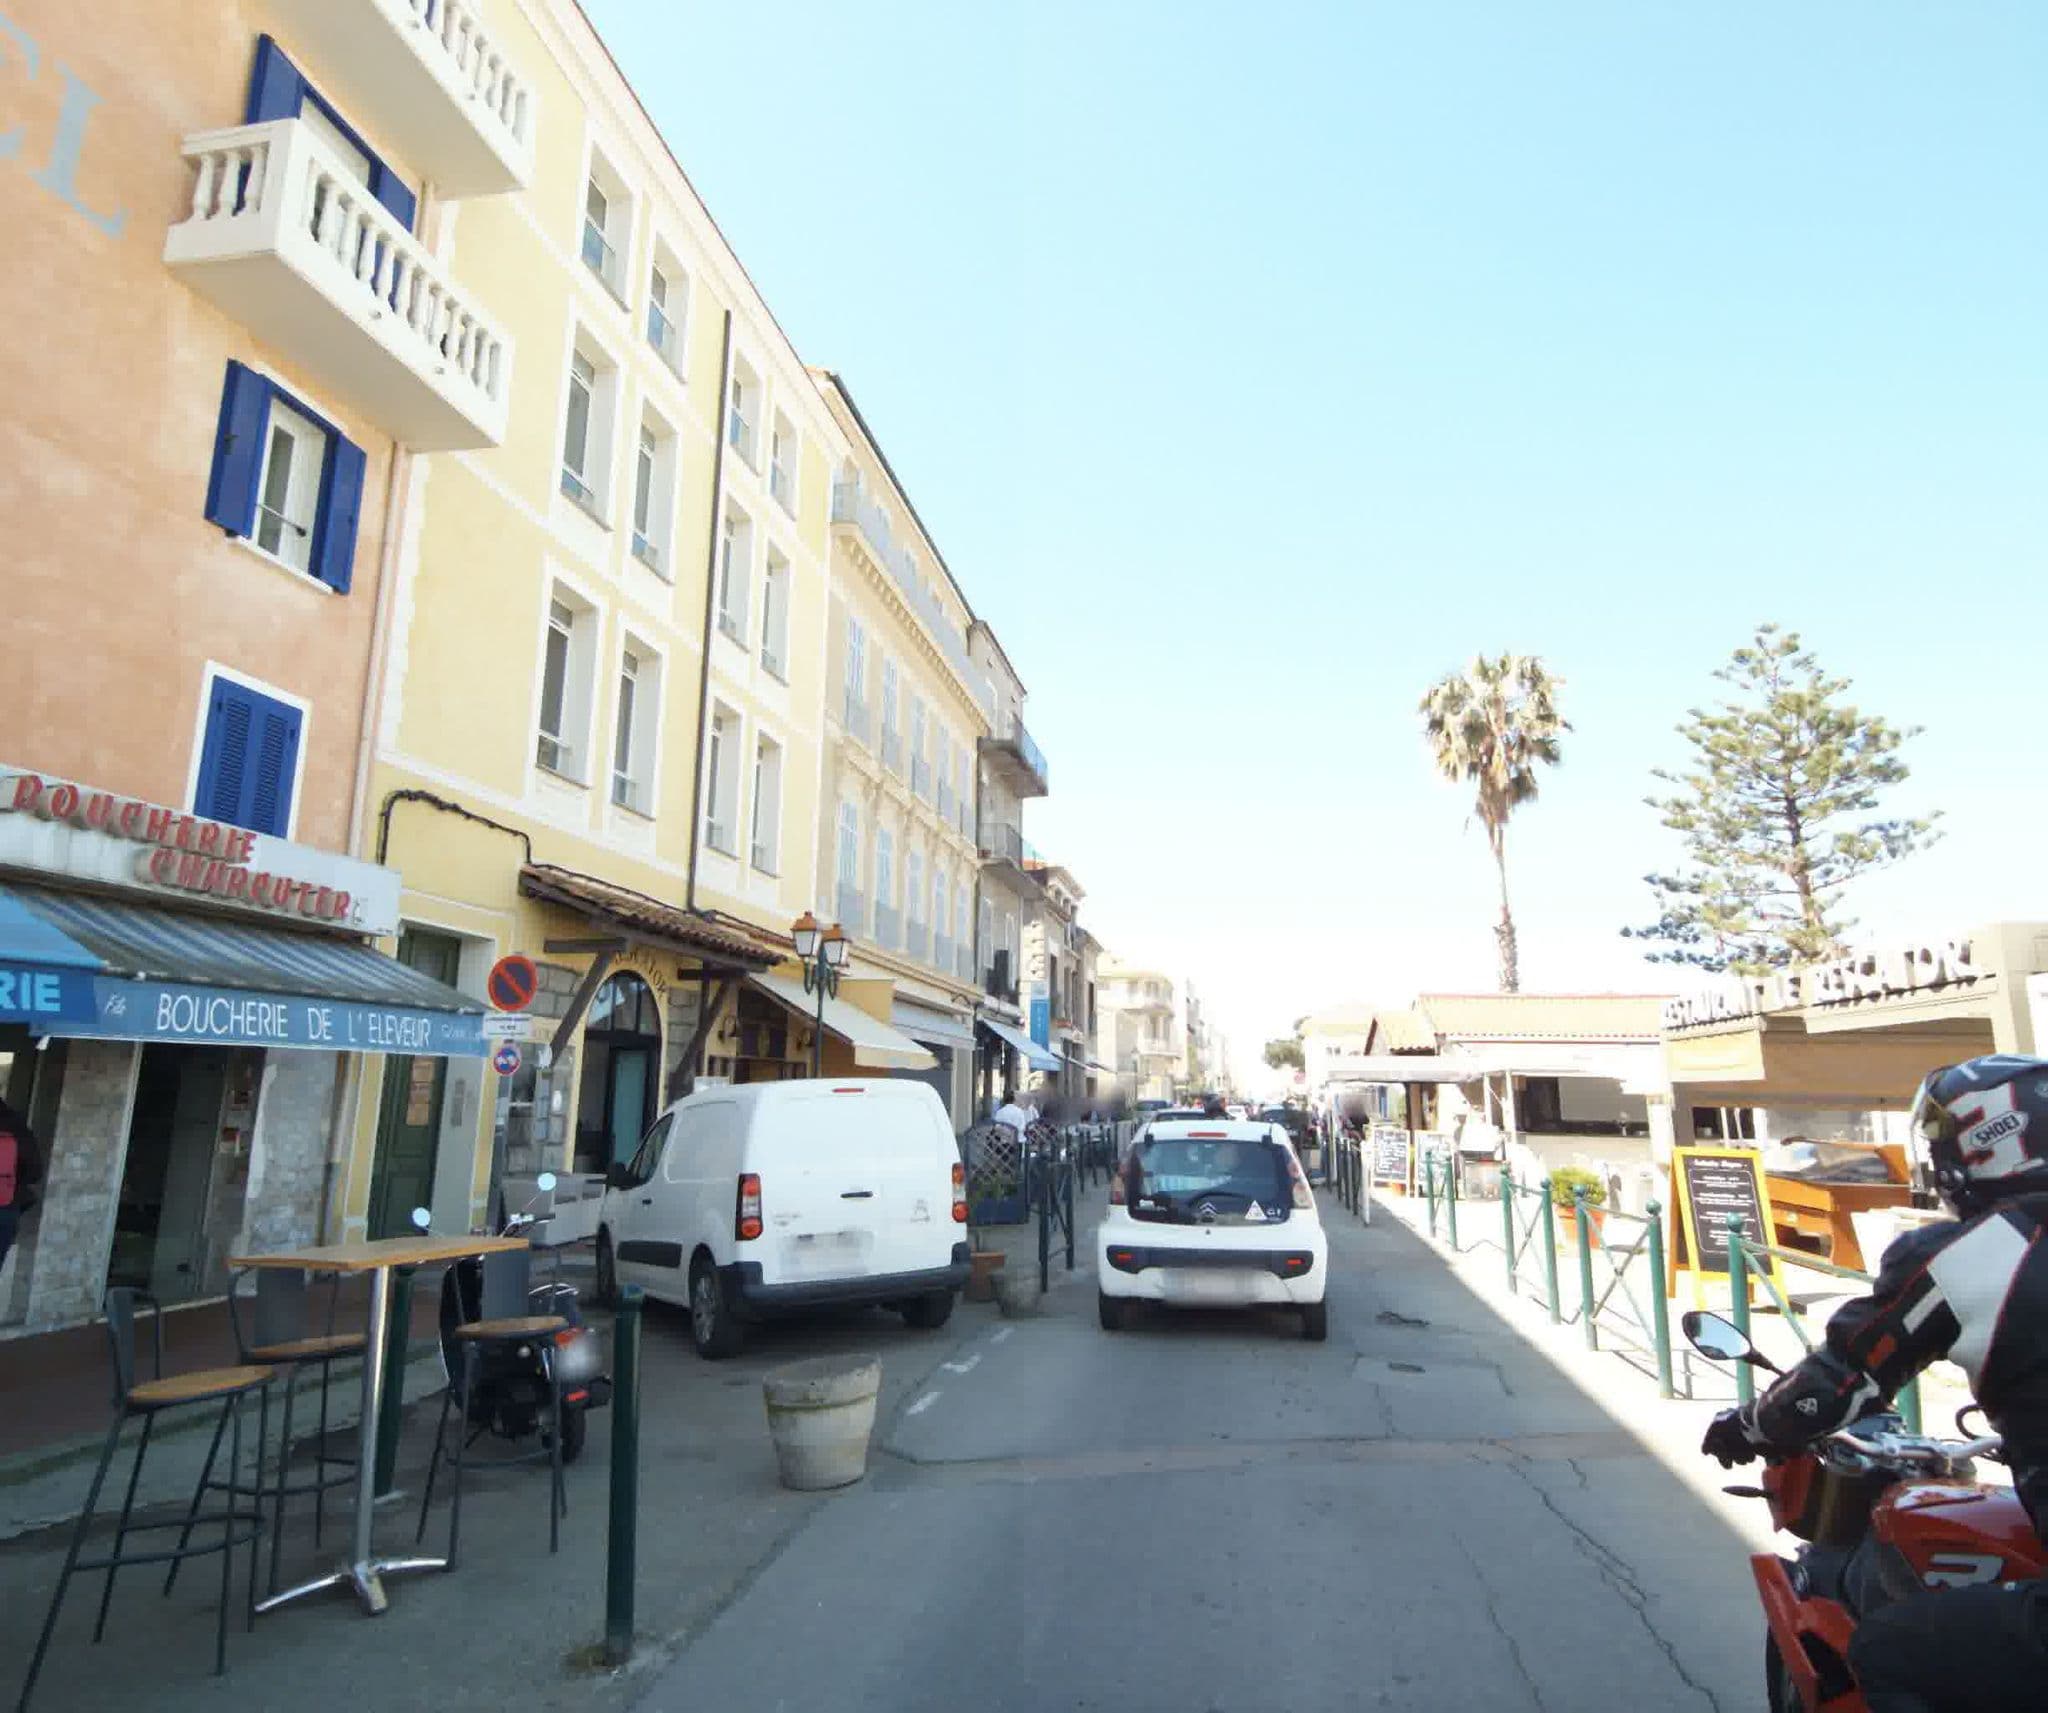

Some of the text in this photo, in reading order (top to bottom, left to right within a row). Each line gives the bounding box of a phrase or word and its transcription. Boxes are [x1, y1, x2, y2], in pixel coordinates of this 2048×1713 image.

[156, 992, 289, 1038] BOUCHERIE
[307, 1007, 333, 1041] DE
[1975, 1114, 2020, 1145] SHOEI
